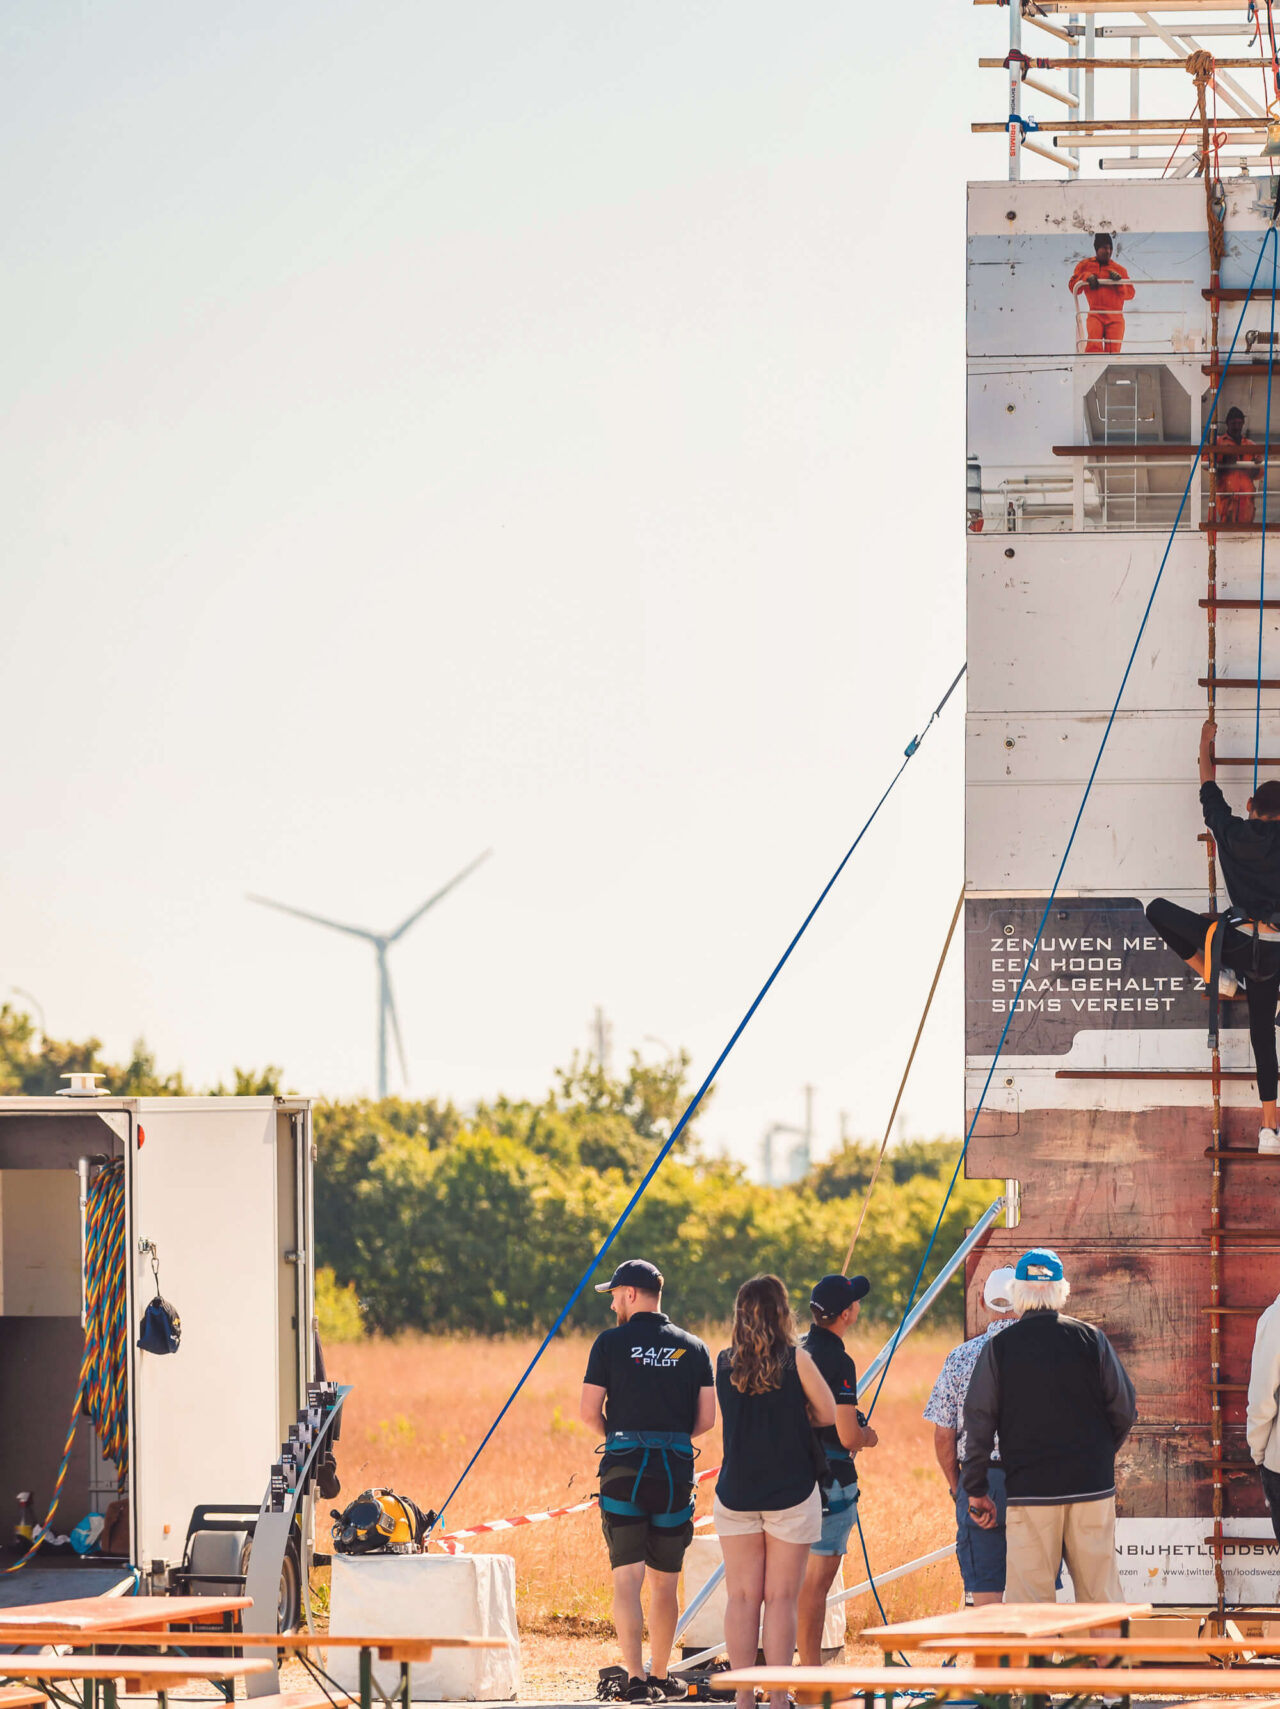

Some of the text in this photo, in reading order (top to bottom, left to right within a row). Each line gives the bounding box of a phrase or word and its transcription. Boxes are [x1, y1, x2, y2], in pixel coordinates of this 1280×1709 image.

[990, 937, 1112, 952] ZENUWEN
[991, 958, 1122, 972] EEN HOOG
[991, 977, 1247, 992] STAALGEHALTE ZN
[991, 998, 1176, 1012] SOMS VEREIST
[631, 1347, 676, 1358] 24/7
[643, 1358, 679, 1367] PILOT
